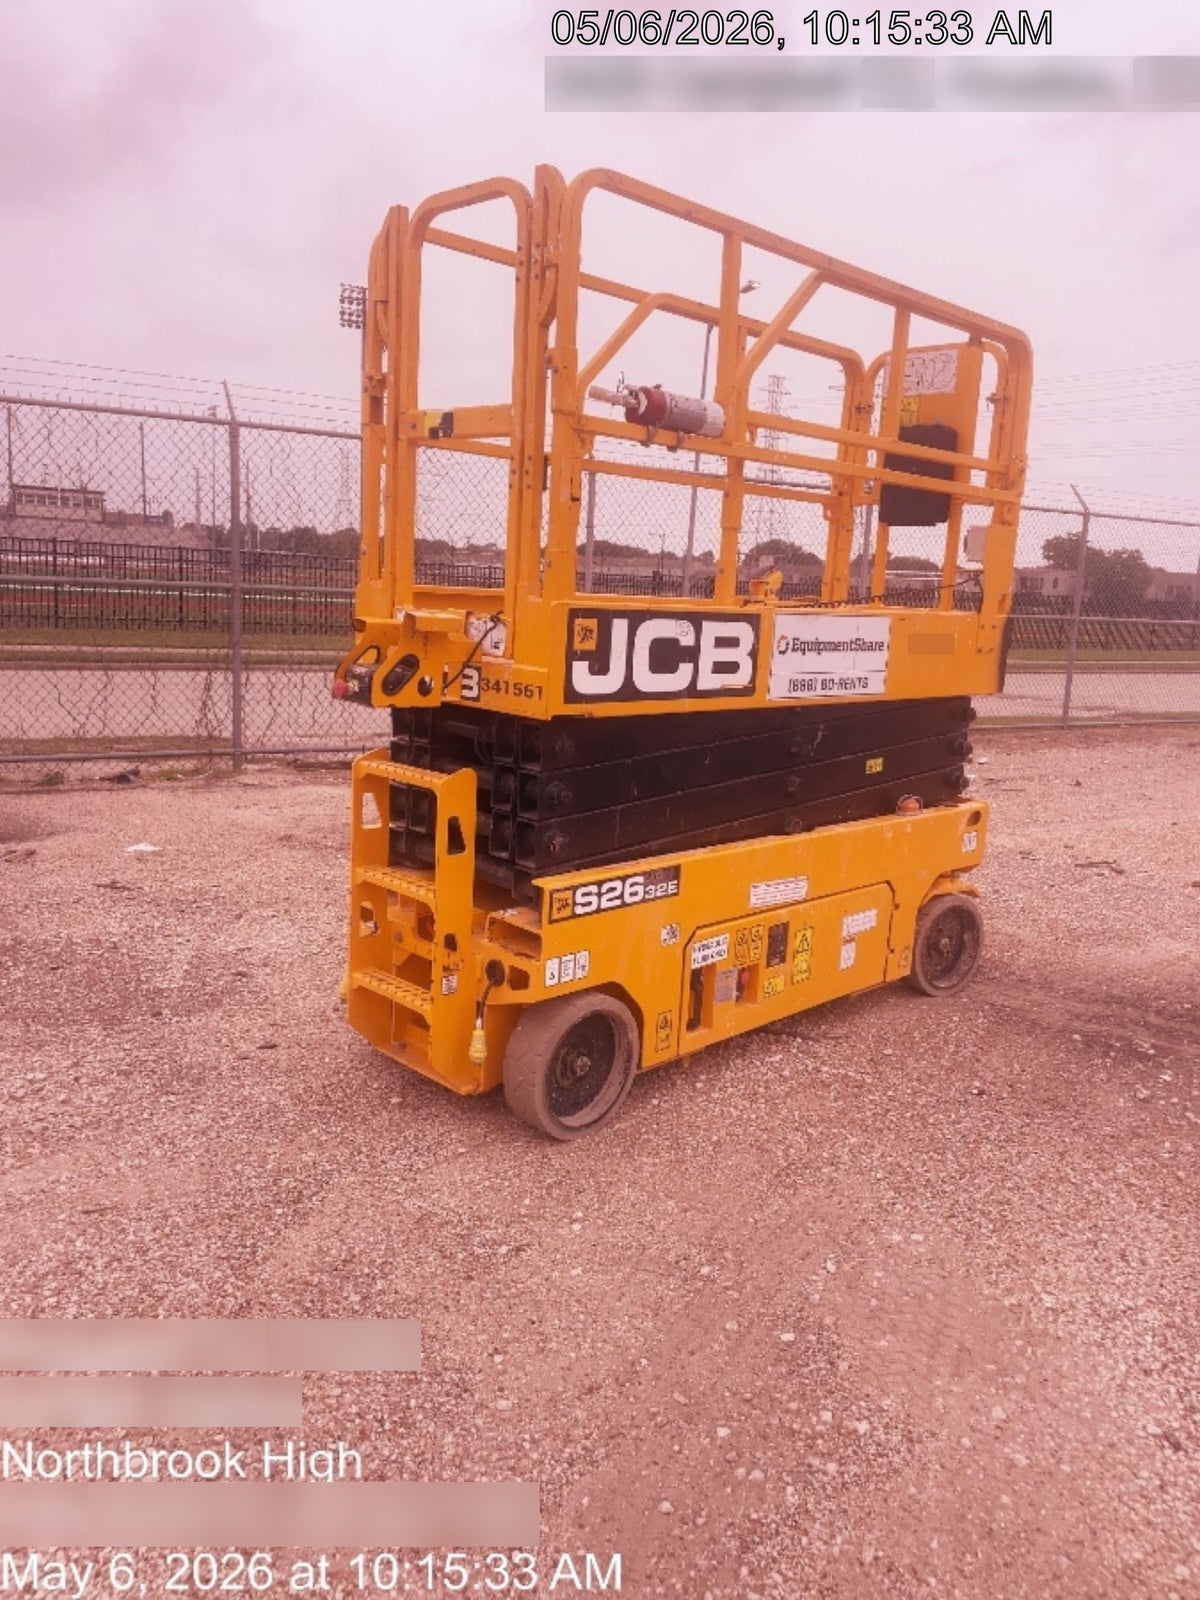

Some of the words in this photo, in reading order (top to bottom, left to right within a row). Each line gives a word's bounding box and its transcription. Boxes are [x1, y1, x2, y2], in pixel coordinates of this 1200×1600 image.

[572, 618, 755, 695] JCB
[791, 637, 885, 655] EquipmentShare
[573, 876, 644, 914] S26
